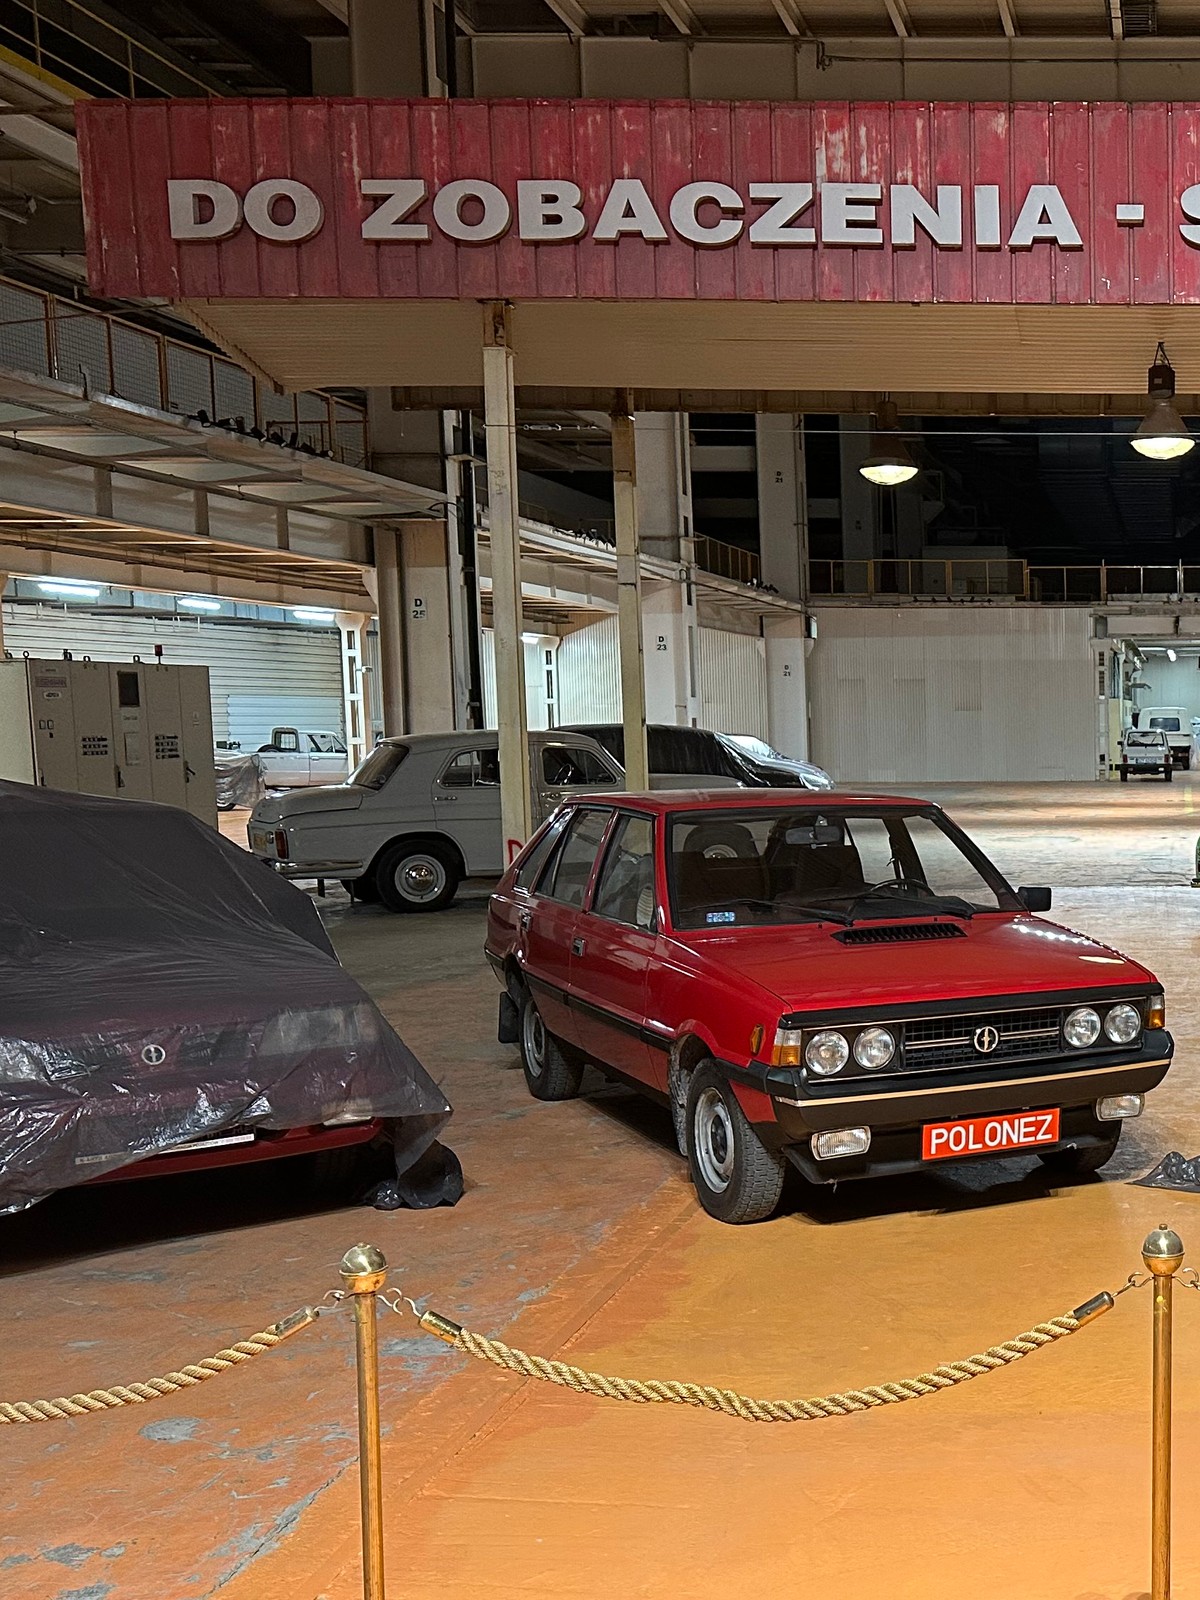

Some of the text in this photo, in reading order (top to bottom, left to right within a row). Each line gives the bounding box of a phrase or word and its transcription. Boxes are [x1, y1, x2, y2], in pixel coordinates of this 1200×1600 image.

[166, 178, 324, 242] DO
[360, 178, 1084, 250] ZOBACZENIA
[1115, 203, 1145, 225] -
[414, 598, 423, 607] D
[412, 609, 426, 619] 25
[658, 635, 665, 643] D
[656, 643, 667, 651] 23
[930, 1114, 1053, 1155] POLONEZ
